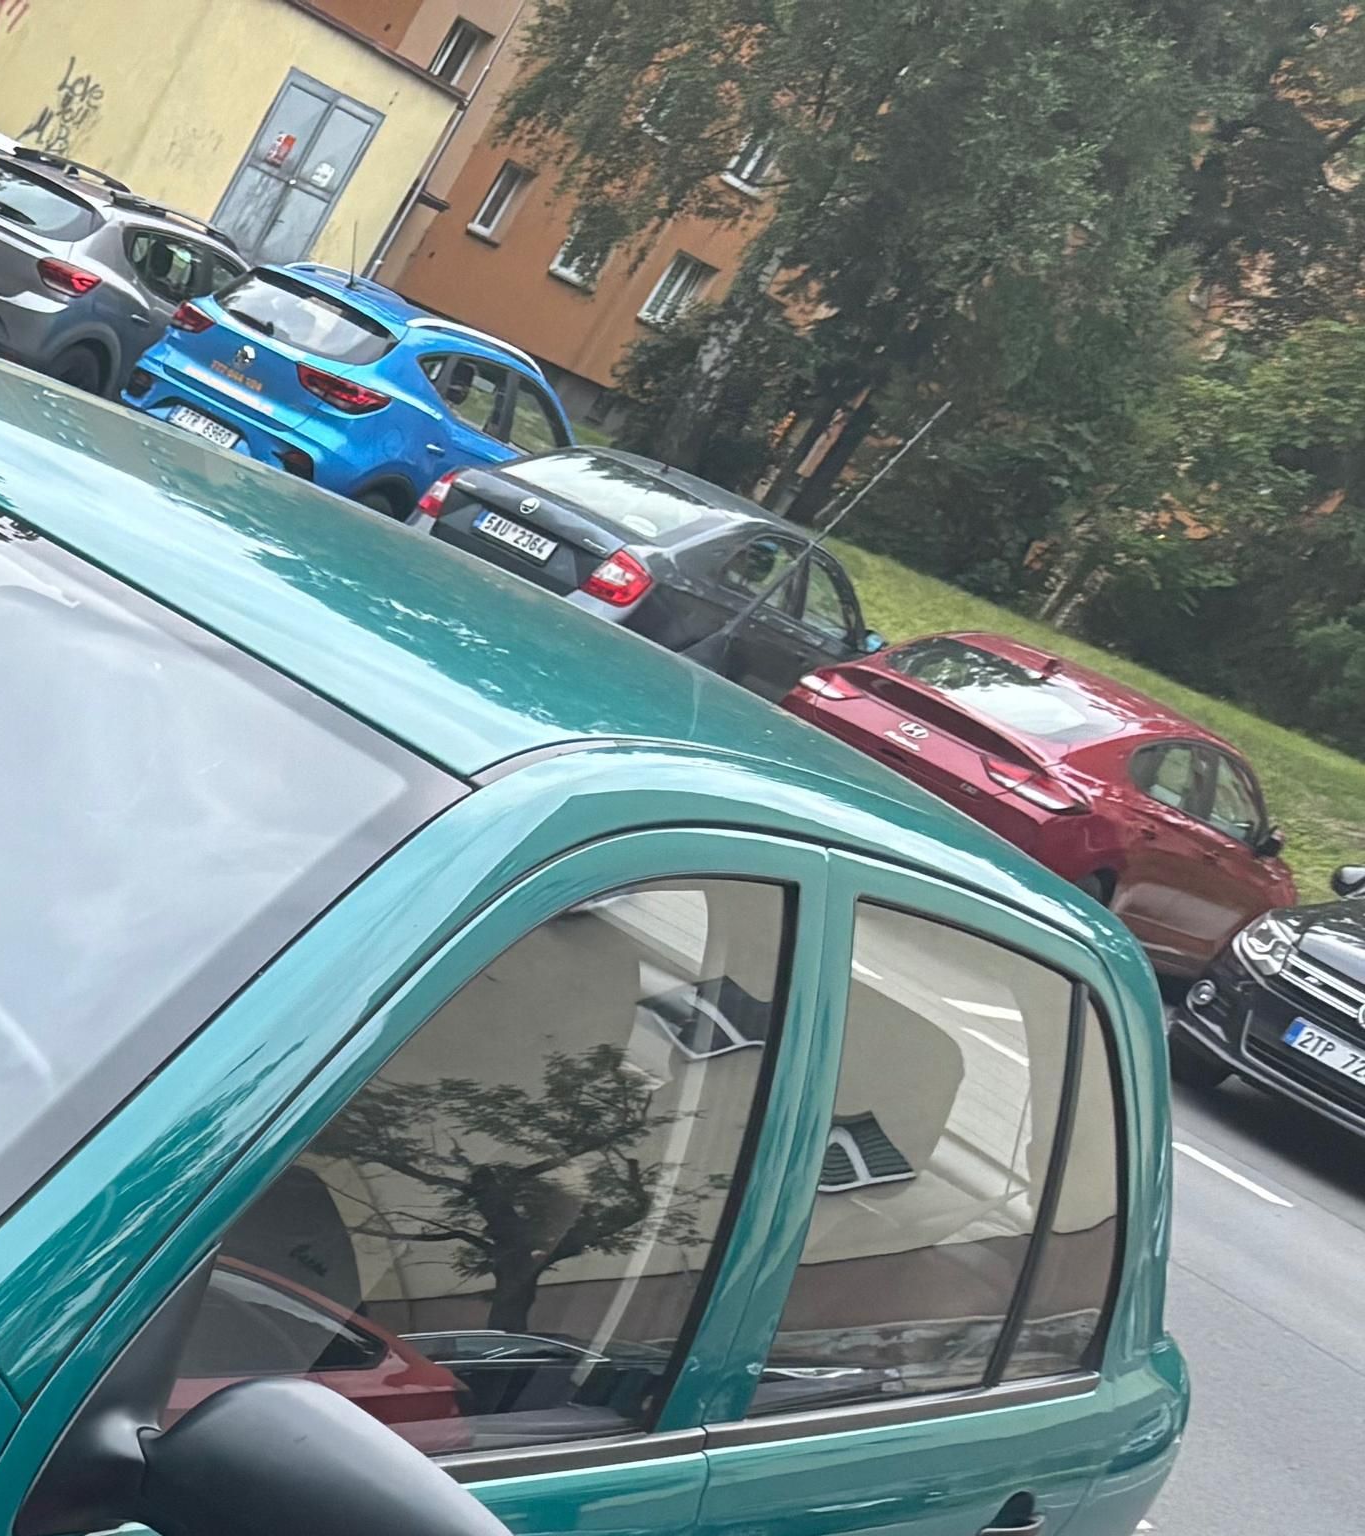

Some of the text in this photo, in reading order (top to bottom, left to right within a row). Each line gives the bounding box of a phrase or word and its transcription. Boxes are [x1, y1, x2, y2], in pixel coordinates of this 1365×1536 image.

[484, 515, 549, 555] 5AU 2364
[1297, 1031, 1336, 1057] 2TP
